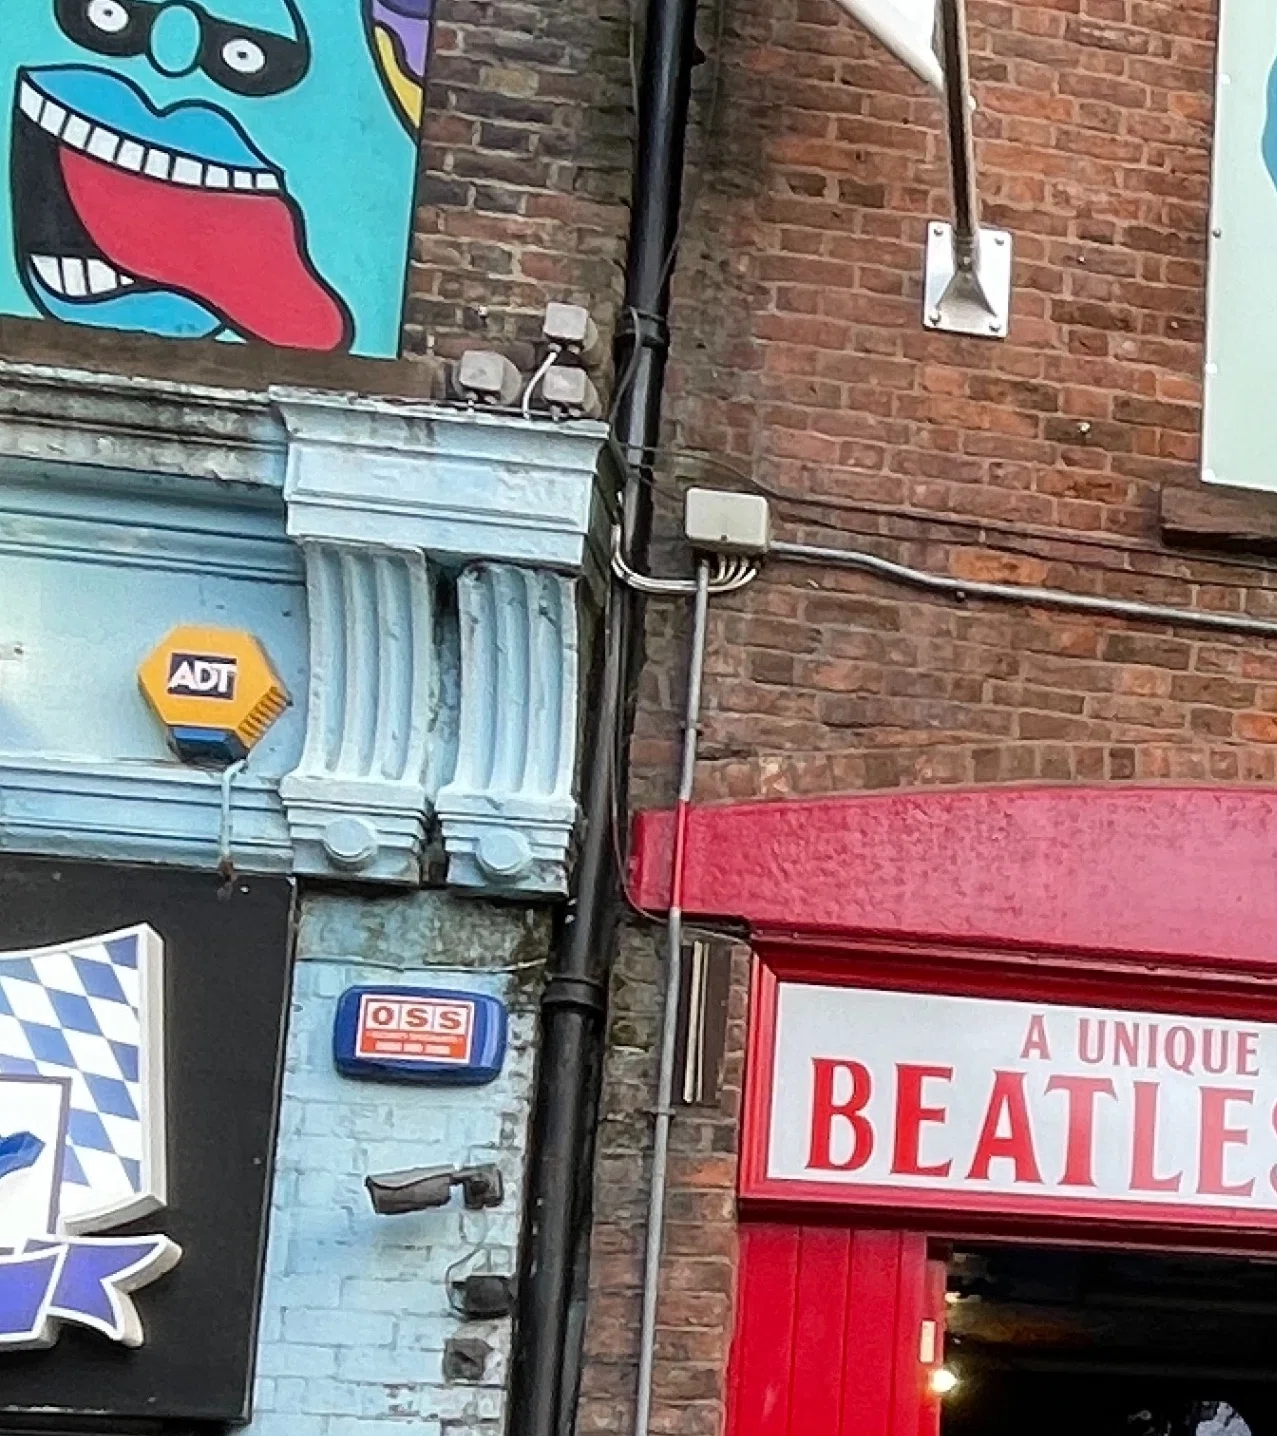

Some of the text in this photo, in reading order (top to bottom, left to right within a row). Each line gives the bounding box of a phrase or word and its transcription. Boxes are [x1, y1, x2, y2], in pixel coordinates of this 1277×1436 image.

[168, 660, 237, 693] ADT
[372, 1005, 462, 1030] OSS
[1019, 1013, 1052, 1061] A
[1077, 1017, 1263, 1078] UNIQUE
